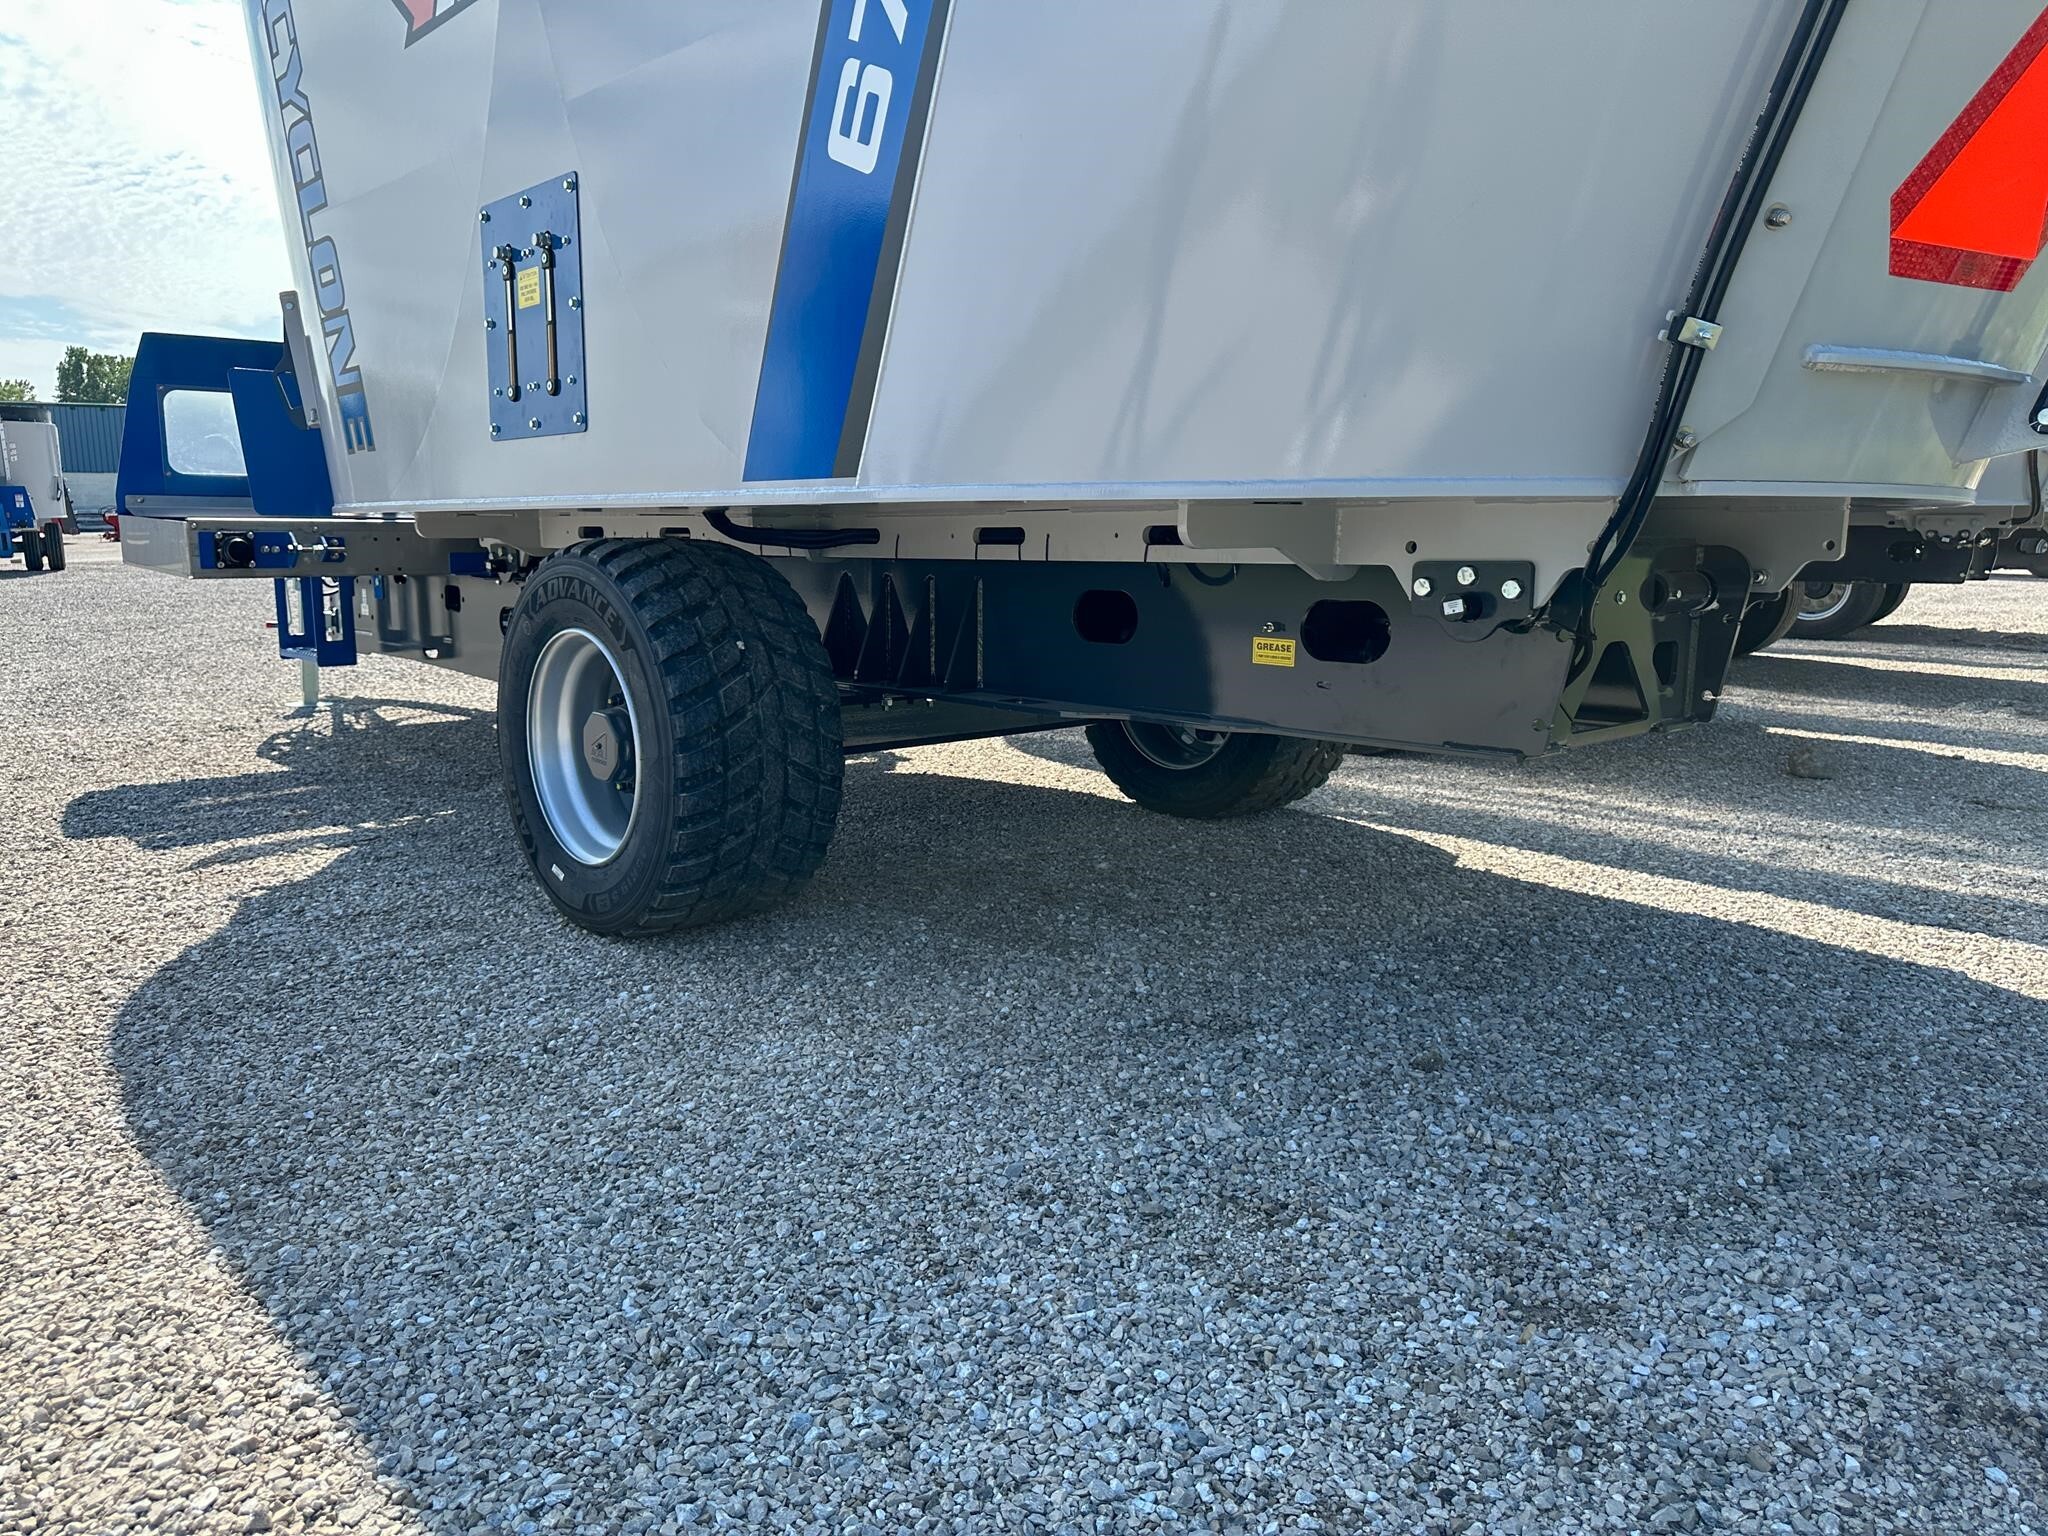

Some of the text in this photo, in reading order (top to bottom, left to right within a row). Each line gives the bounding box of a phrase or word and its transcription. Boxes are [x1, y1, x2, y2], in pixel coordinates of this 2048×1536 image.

[261, 0, 377, 455] CYCLONE
[536, 577, 618, 629] ADVANCE
[1256, 642, 1292, 653] GREASE
